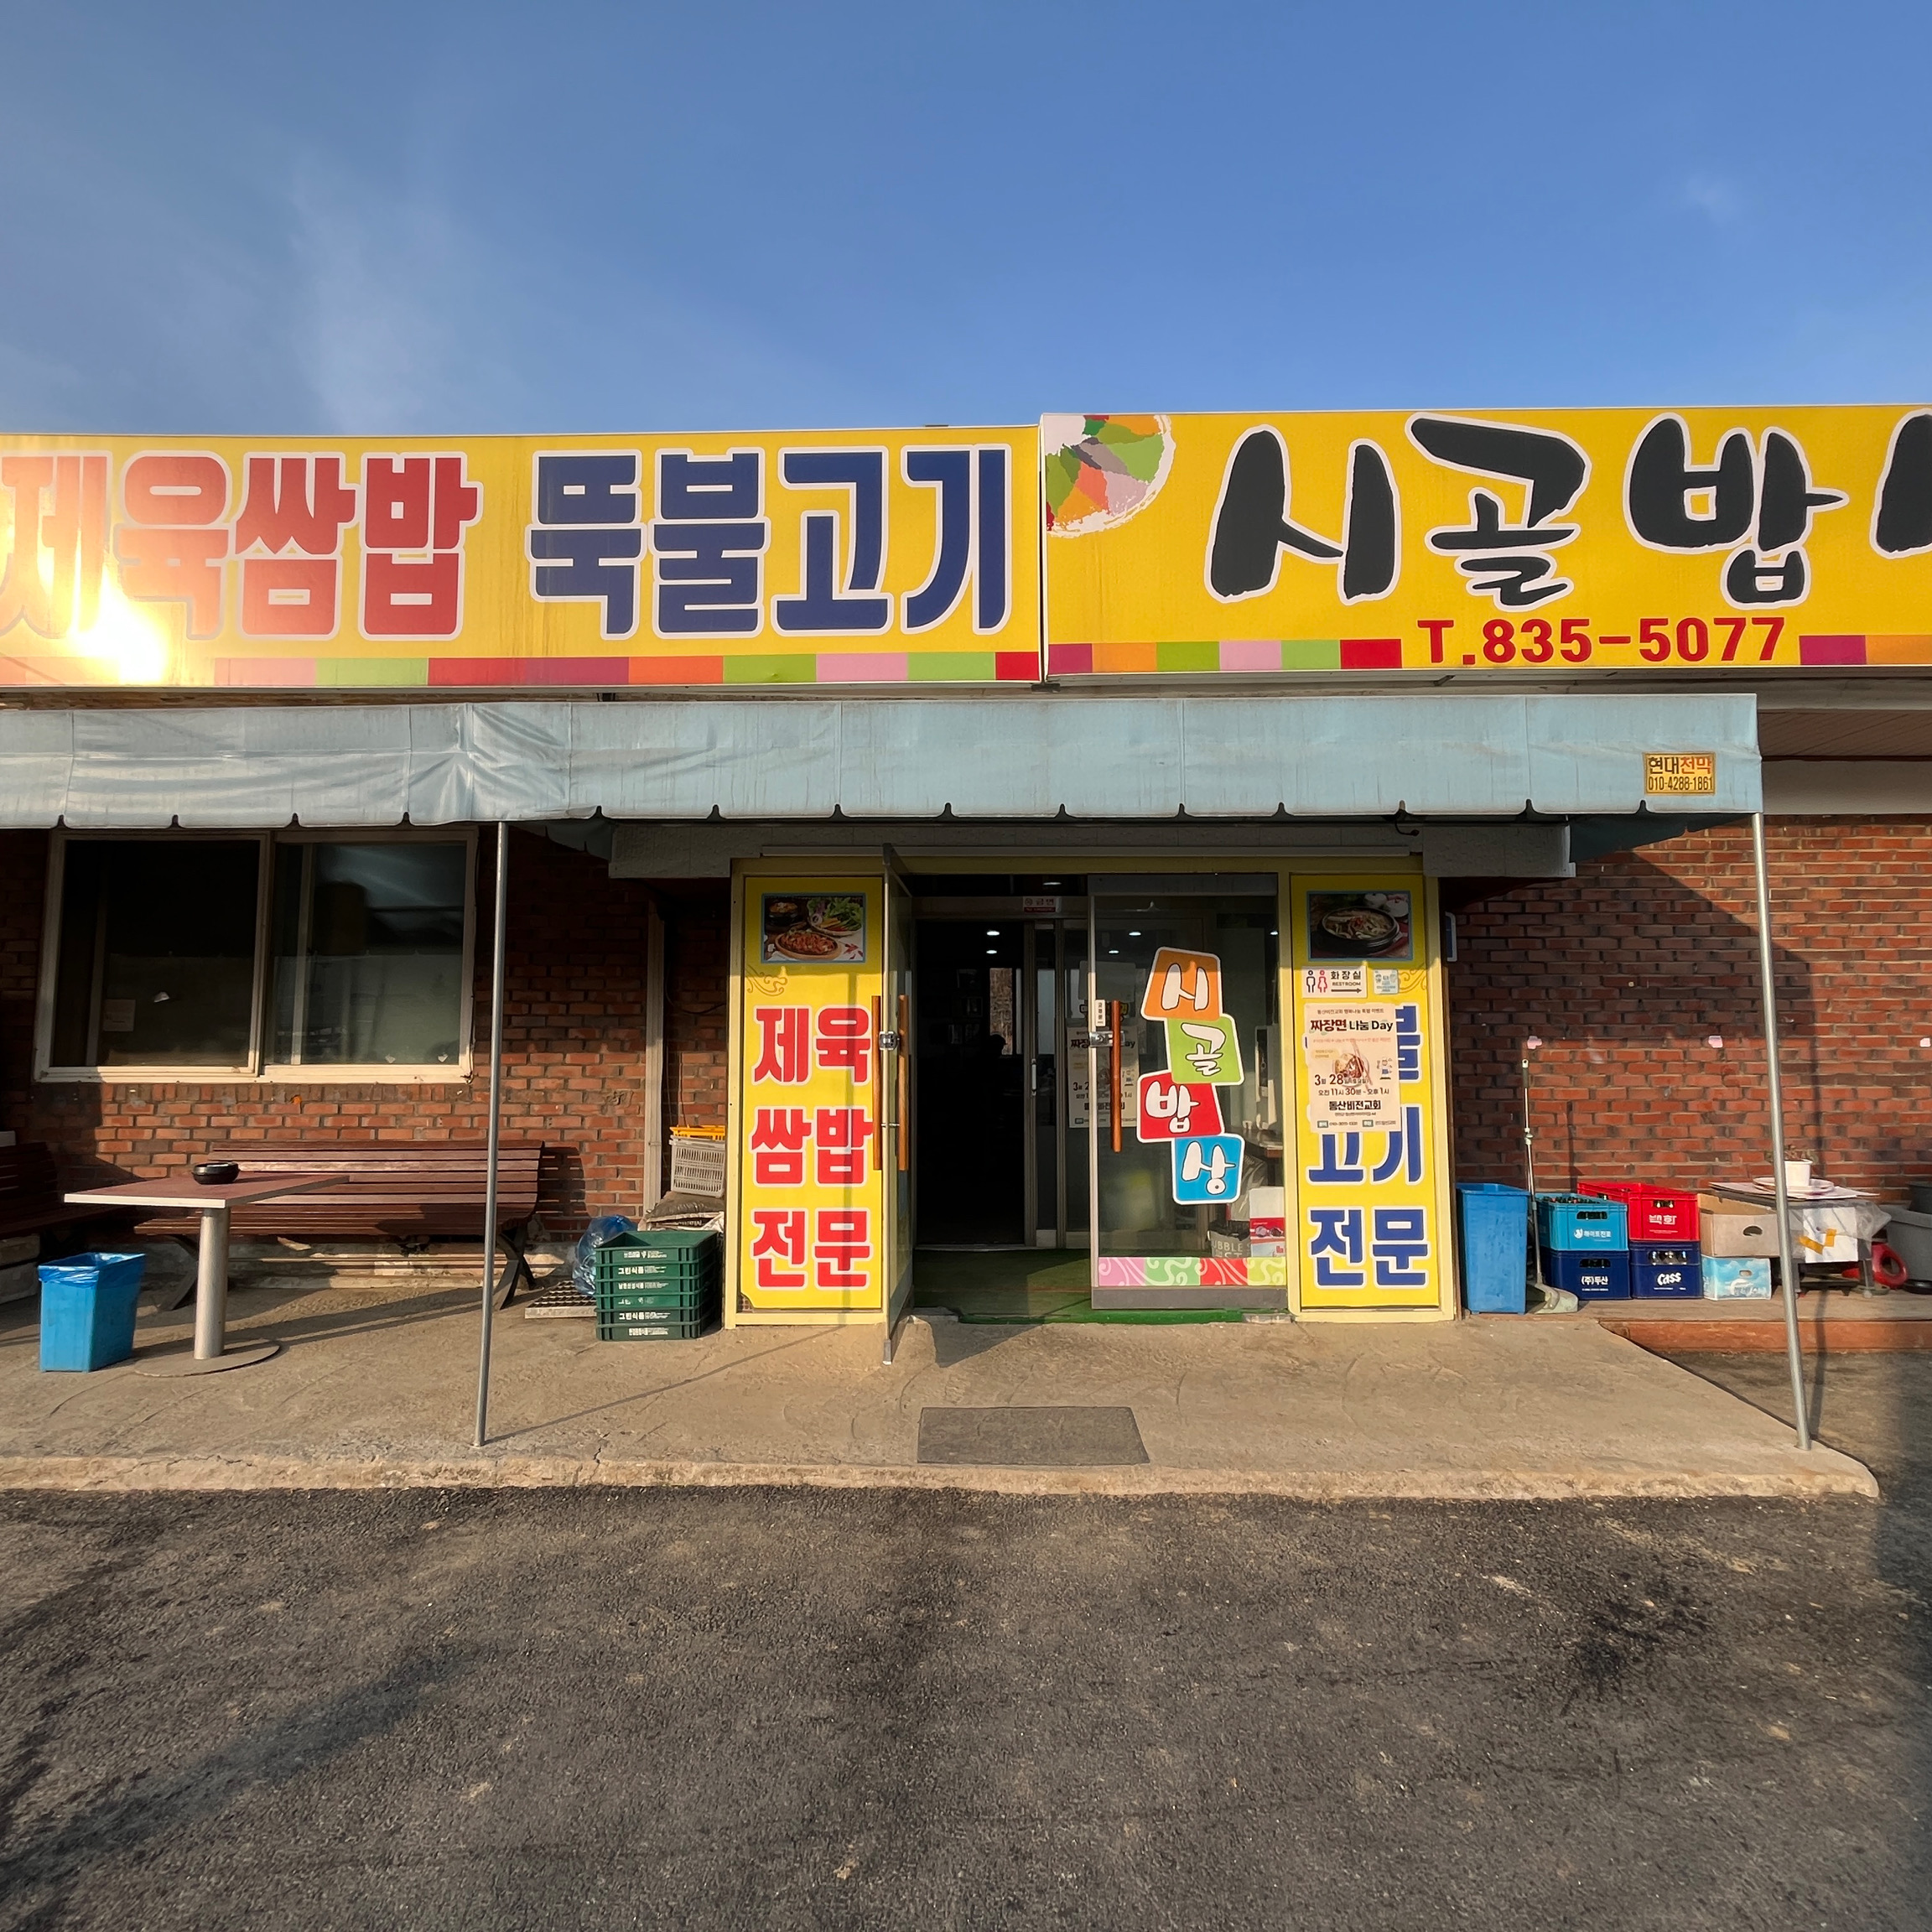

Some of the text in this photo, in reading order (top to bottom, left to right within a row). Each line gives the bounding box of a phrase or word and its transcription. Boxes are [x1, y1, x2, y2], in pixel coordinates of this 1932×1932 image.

[0, 446, 1010, 639] 제육쌈밥 뚝불고기
[1418, 616, 1784, 665] T.835-5077
[1648, 756, 1712, 775] 현대천막
[1648, 776, 1713, 791] 010-4288-1861
[754, 1006, 871, 1084] 제육
[1311, 1019, 1393, 1032] 짜장면 나눔 Day
[751, 1108, 874, 1184] 쌈밥
[753, 1210, 870, 1288] 전문
[1310, 1208, 1428, 1286] 전문
